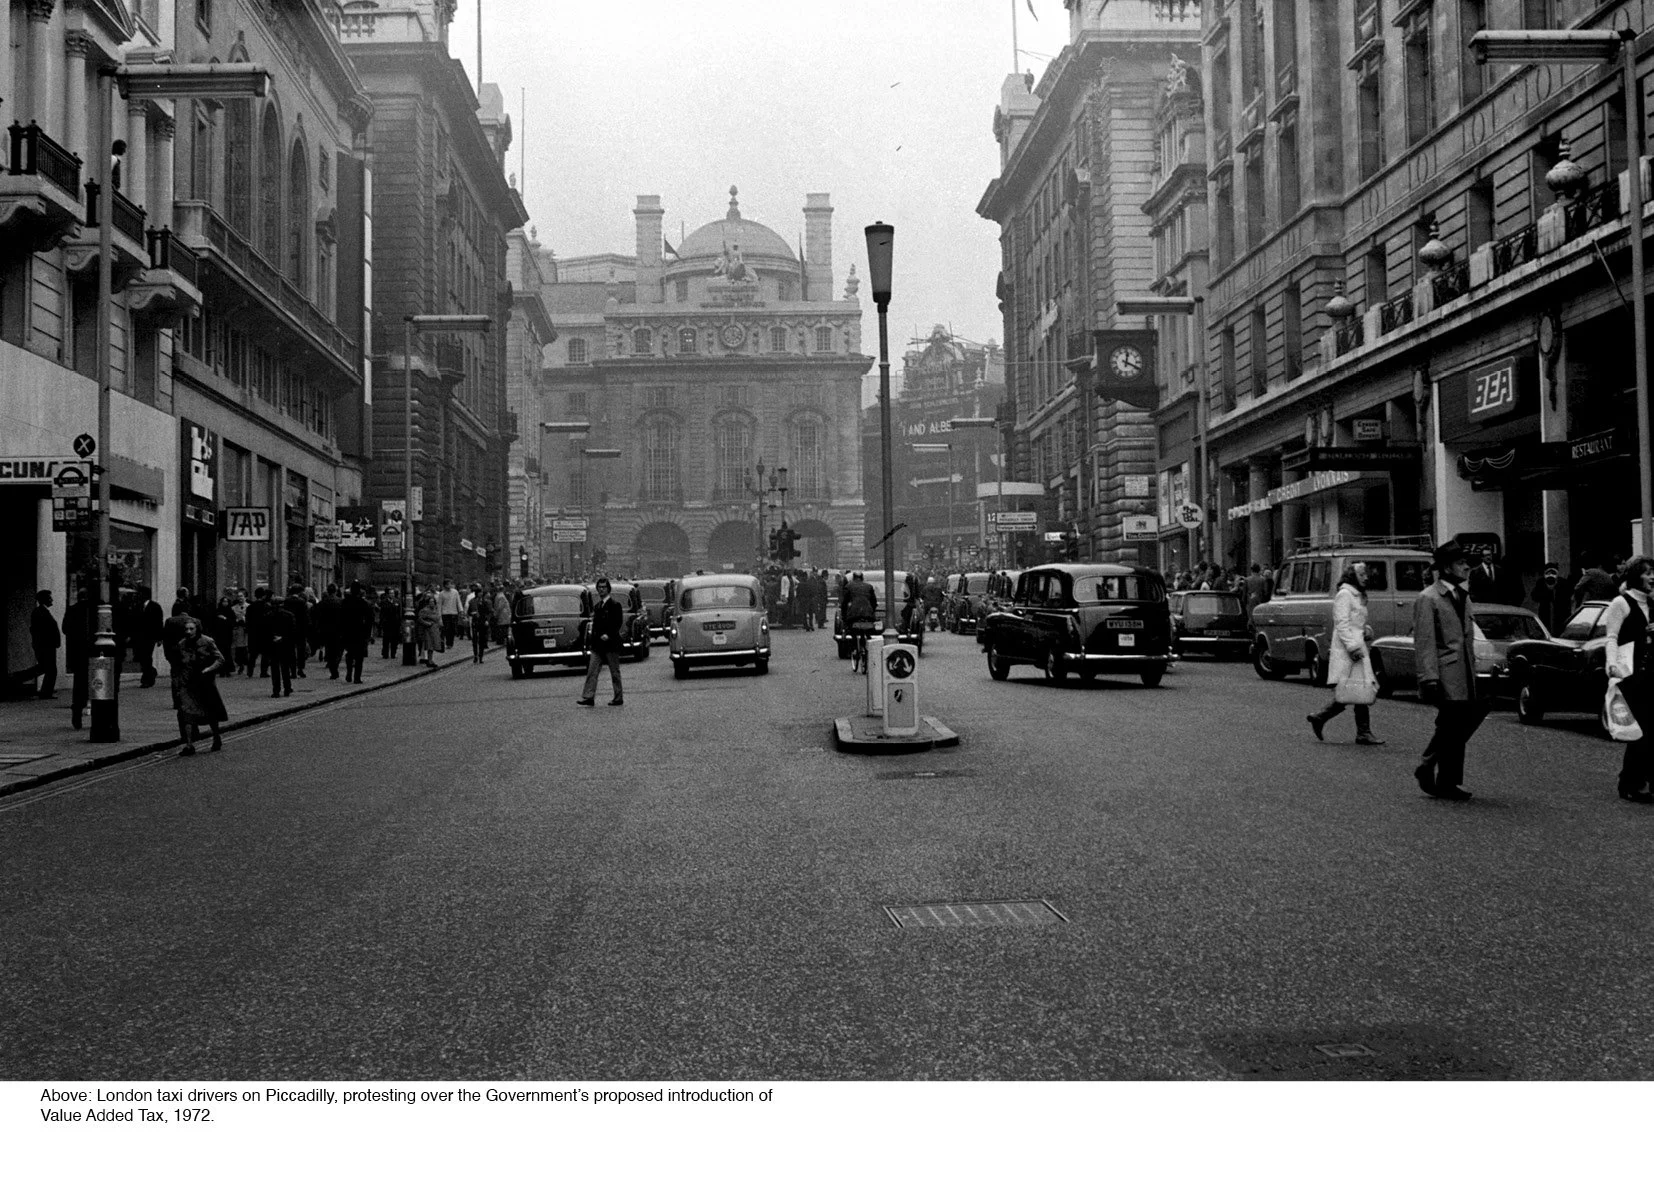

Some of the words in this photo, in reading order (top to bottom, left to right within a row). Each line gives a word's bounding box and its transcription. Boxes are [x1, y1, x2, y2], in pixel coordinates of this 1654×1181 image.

[1471, 366, 1513, 414] BEA
[908, 423, 926, 436] AND
[929, 420, 961, 434] ALBE
[77, 437, 91, 453] X
[1571, 436, 1612, 459] RESTAURANT
[230, 512, 267, 536] TAP
[337, 520, 353, 532] The
